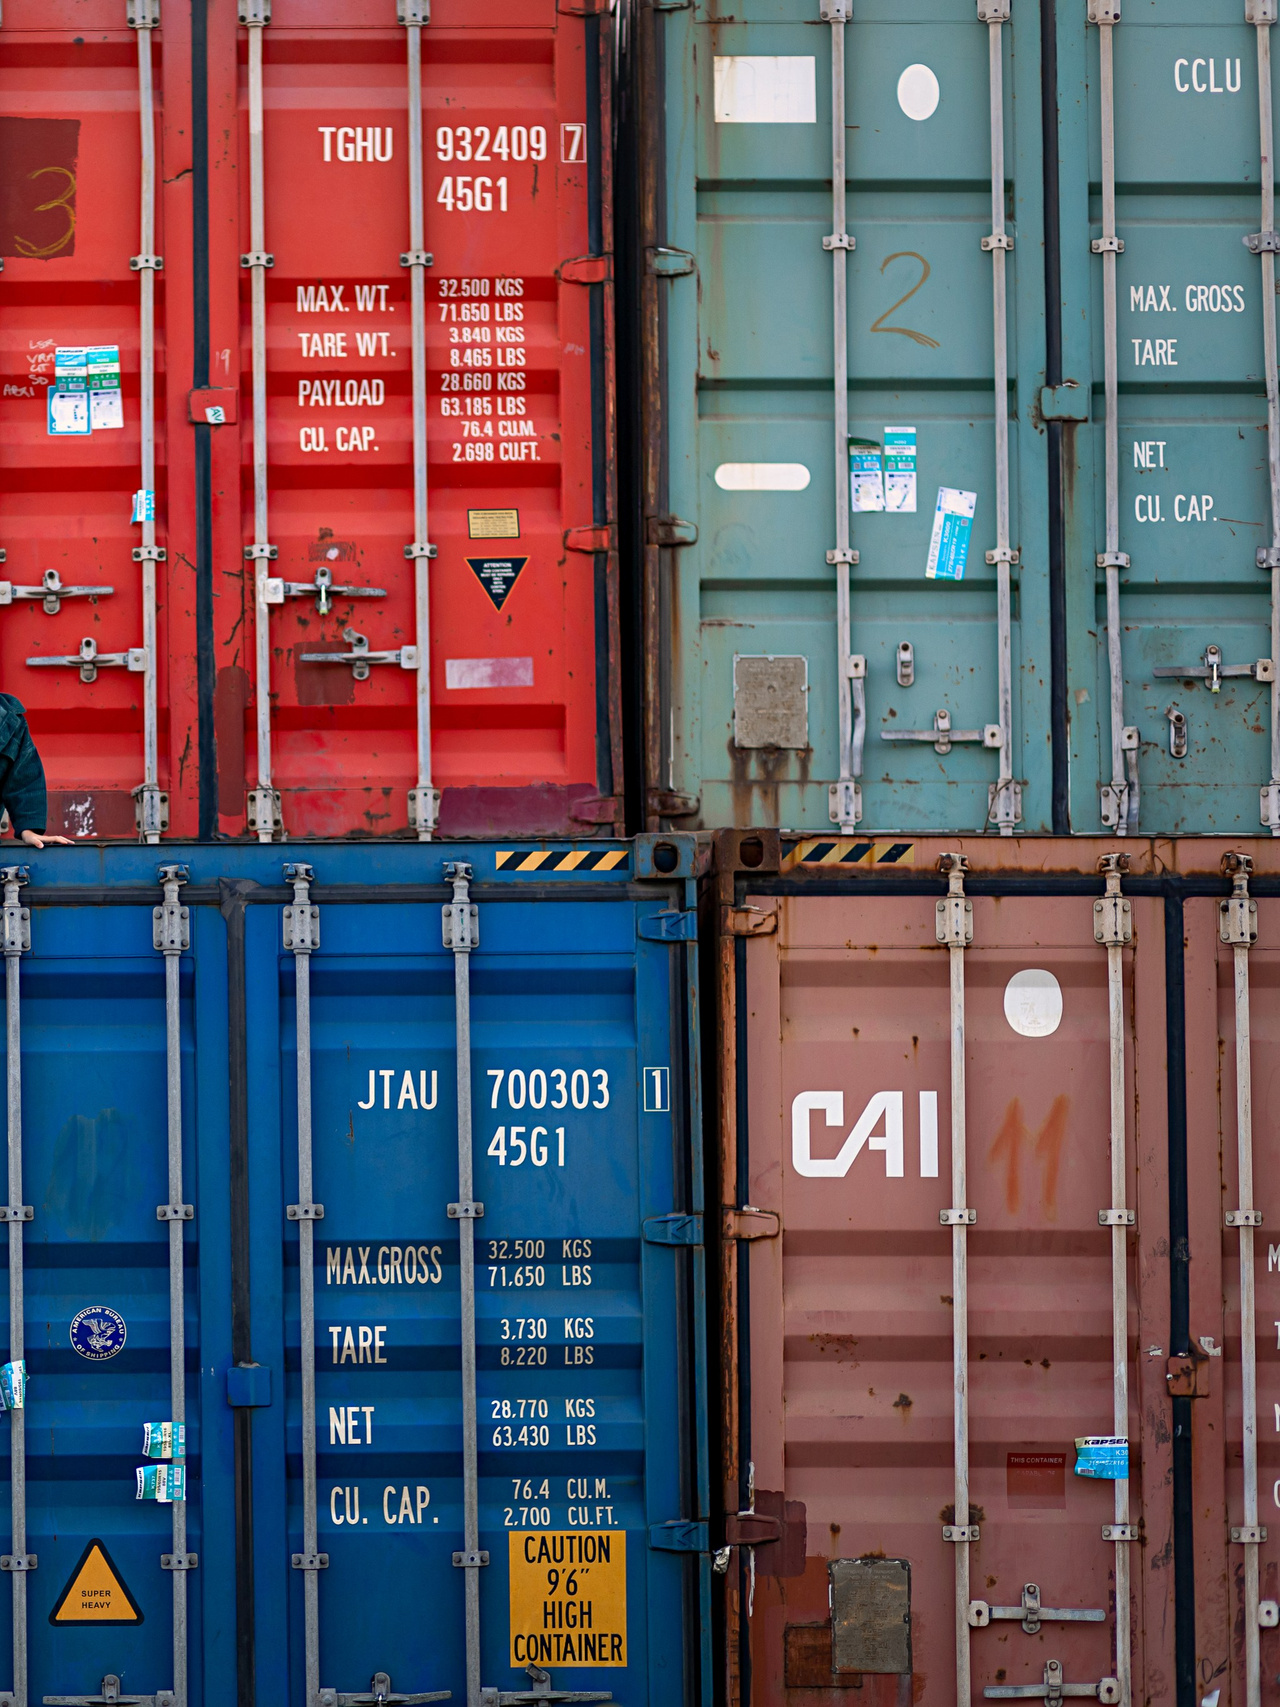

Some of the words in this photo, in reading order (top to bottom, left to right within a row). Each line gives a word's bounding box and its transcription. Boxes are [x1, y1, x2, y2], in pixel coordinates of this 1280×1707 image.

[1175, 59, 1240, 92] CCLU
[318, 127, 392, 161] TGHU
[437, 126, 546, 161] 932409
[567, 126, 581, 160] 7
[437, 177, 507, 211] 45G1
[14, 167, 76, 258] 3
[297, 285, 349, 312] MAX.
[355, 285, 394, 311] WT.
[495, 278, 523, 296] KGS
[870, 251, 940, 349] 2
[1131, 286, 1176, 311] MAX.
[1186, 285, 1244, 312] GROSS
[495, 303, 523, 321] LBS
[299, 333, 347, 357] TARE
[356, 333, 396, 356] WT.
[496, 327, 524, 342] KGS
[497, 348, 525, 366] LBS
[1132, 339, 1177, 365] TARE
[299, 379, 384, 406] PAYLOAD
[498, 372, 525, 390] KGS
[497, 397, 525, 415] LBS
[300, 427, 328, 452] CU.
[336, 427, 379, 451] CAP.
[461, 421, 493, 437] 76.4
[1134, 442, 1166, 467] NET
[1135, 495, 1165, 522] CU.
[1175, 495, 1217, 522] CAP.
[358, 1070, 437, 1110] JTAU
[487, 1069, 609, 1109] 700303
[488, 1126, 564, 1166] 45G1
[792, 1091, 938, 1177] CAI
[989, 1093, 1070, 1221] 11
[489, 1240, 544, 1259] 32,500
[563, 1239, 591, 1258] KGS
[327, 1246, 442, 1284] MAX.GROSS
[488, 1266, 544, 1286] 71,650
[563, 1265, 591, 1285] LBS
[72, 1308, 101, 1333] AMERICAN
[105, 1310, 124, 1334] BUREAU
[501, 1319, 546, 1340] 3,730
[565, 1318, 593, 1338] KGS
[86, 1345, 120, 1358] SHIPPING
[329, 1326, 386, 1363] TARE
[501, 1347, 546, 1365] 8,220
[565, 1346, 593, 1364] LBS
[492, 1400, 548, 1418] 28,770
[566, 1399, 595, 1417] KGS
[330, 1407, 374, 1444] NET
[493, 1426, 549, 1446] 63,430
[567, 1425, 596, 1445] LBS
[512, 1479, 549, 1499] 76.4
[567, 1479, 610, 1499] CU.M.
[331, 1487, 367, 1525] CU.
[384, 1486, 438, 1524] CAP.
[504, 1507, 550, 1525] 2,700
[568, 1507, 618, 1525] CU.FT.
[525, 1536, 610, 1563] CAUTION
[544, 1601, 592, 1628] HIGH
[514, 1634, 622, 1661] CONTAINER
